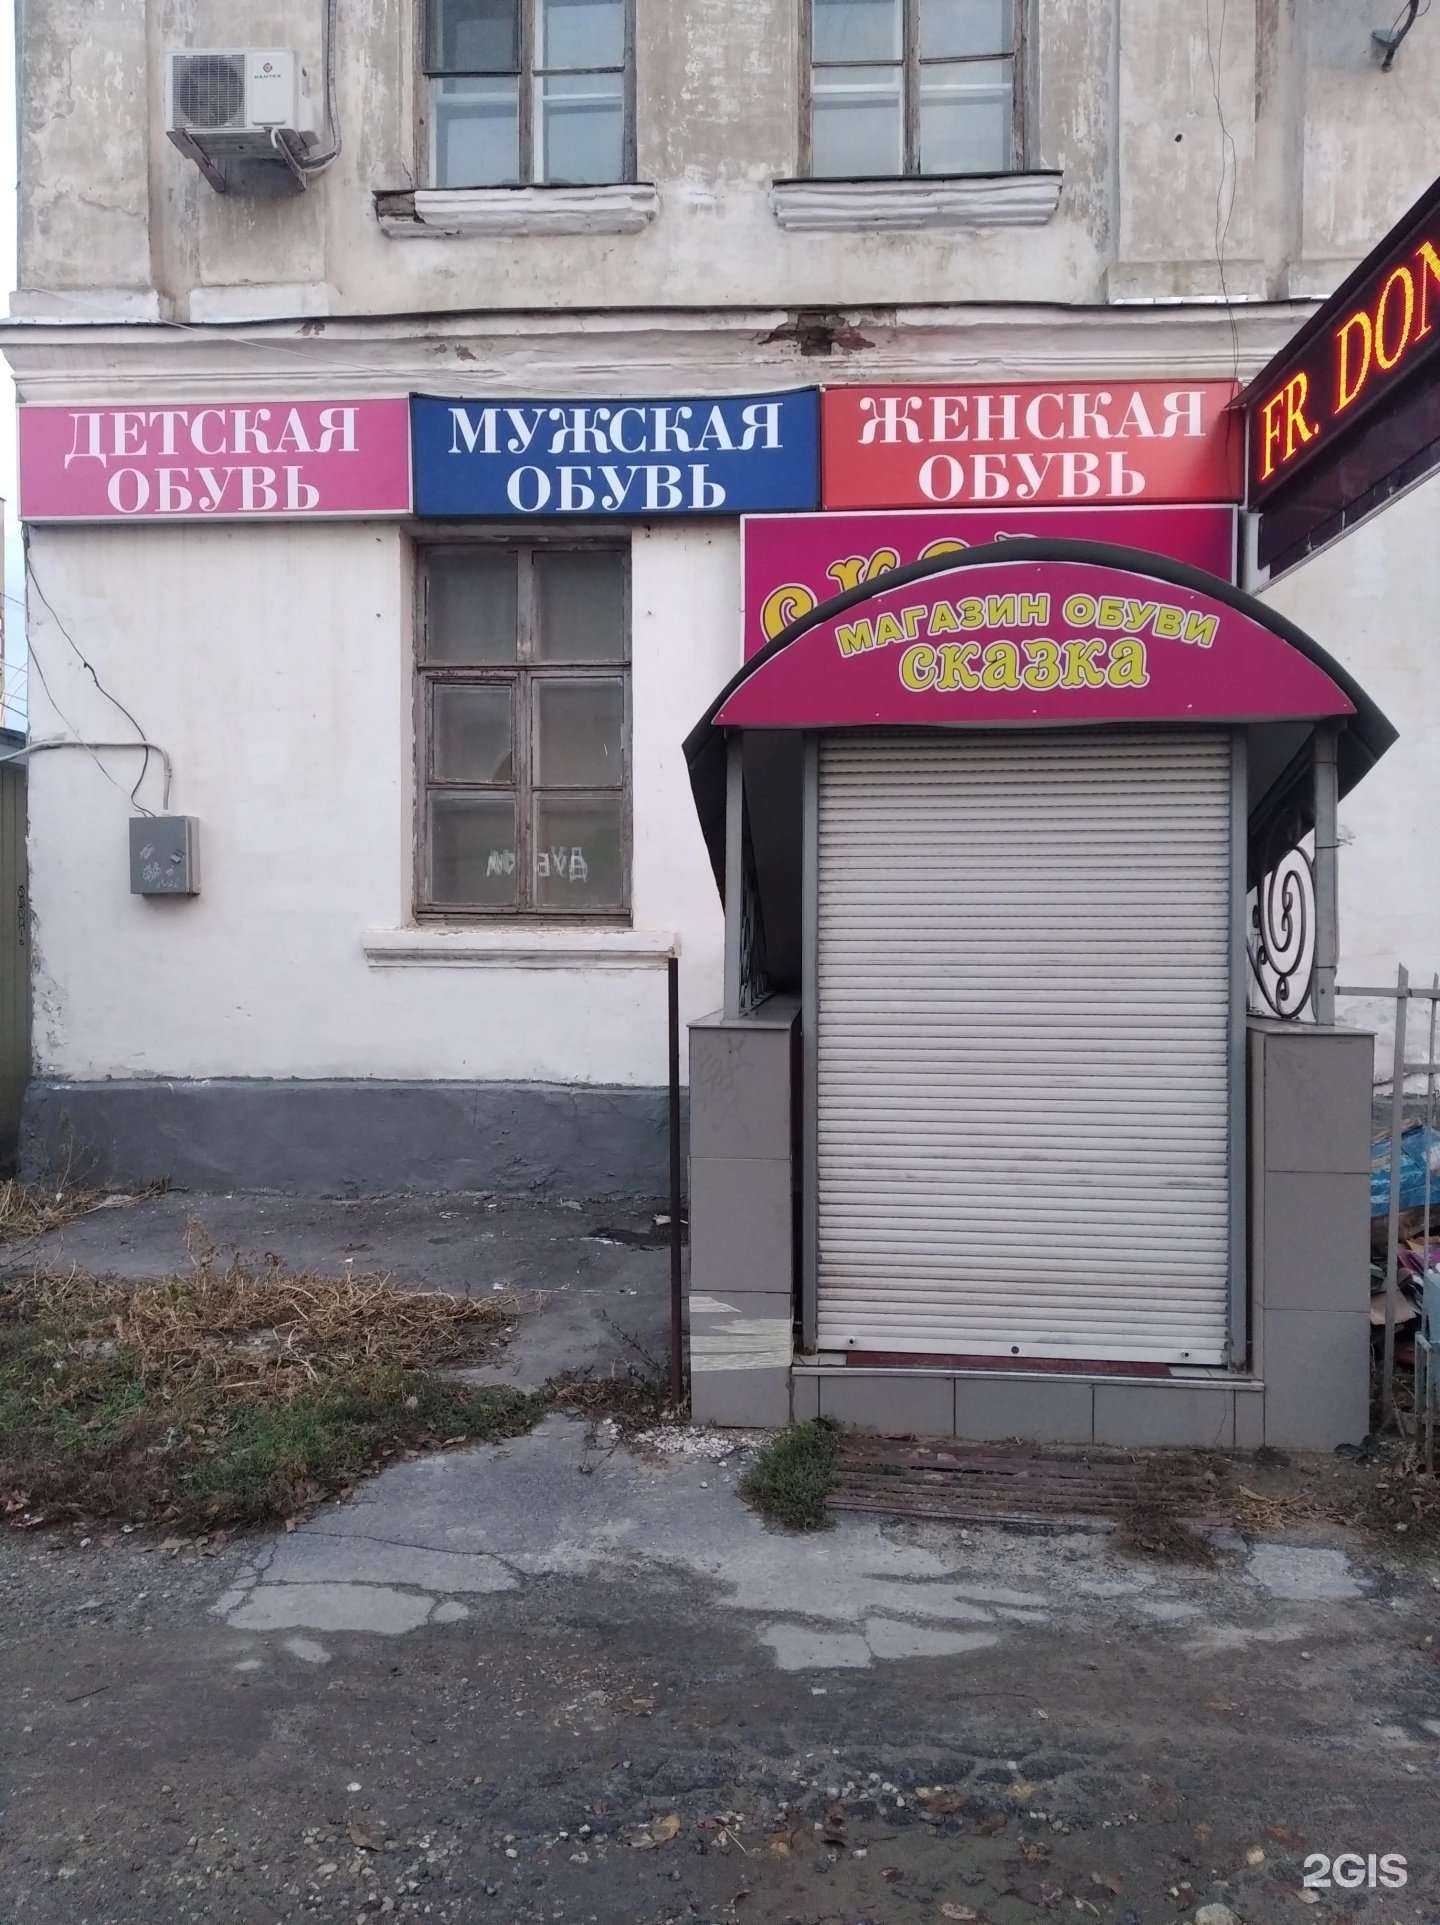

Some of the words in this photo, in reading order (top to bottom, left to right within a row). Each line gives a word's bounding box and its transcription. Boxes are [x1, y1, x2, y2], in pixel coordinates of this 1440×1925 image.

[64, 407, 360, 469] ДЕТСКАЯ
[448, 402, 783, 456] МУЖСКАЯ
[858, 391, 1206, 445] ЖЕНСКАЯ
[1261, 371, 1320, 481] FR.
[107, 464, 321, 513] ОБУВЬ
[507, 463, 727, 513] ОБУВЬ
[918, 451, 1146, 502] ОБУВЬ
[836, 592, 1050, 658] МАГАЗИН
[1063, 594, 1220, 649] ОБУВИ
